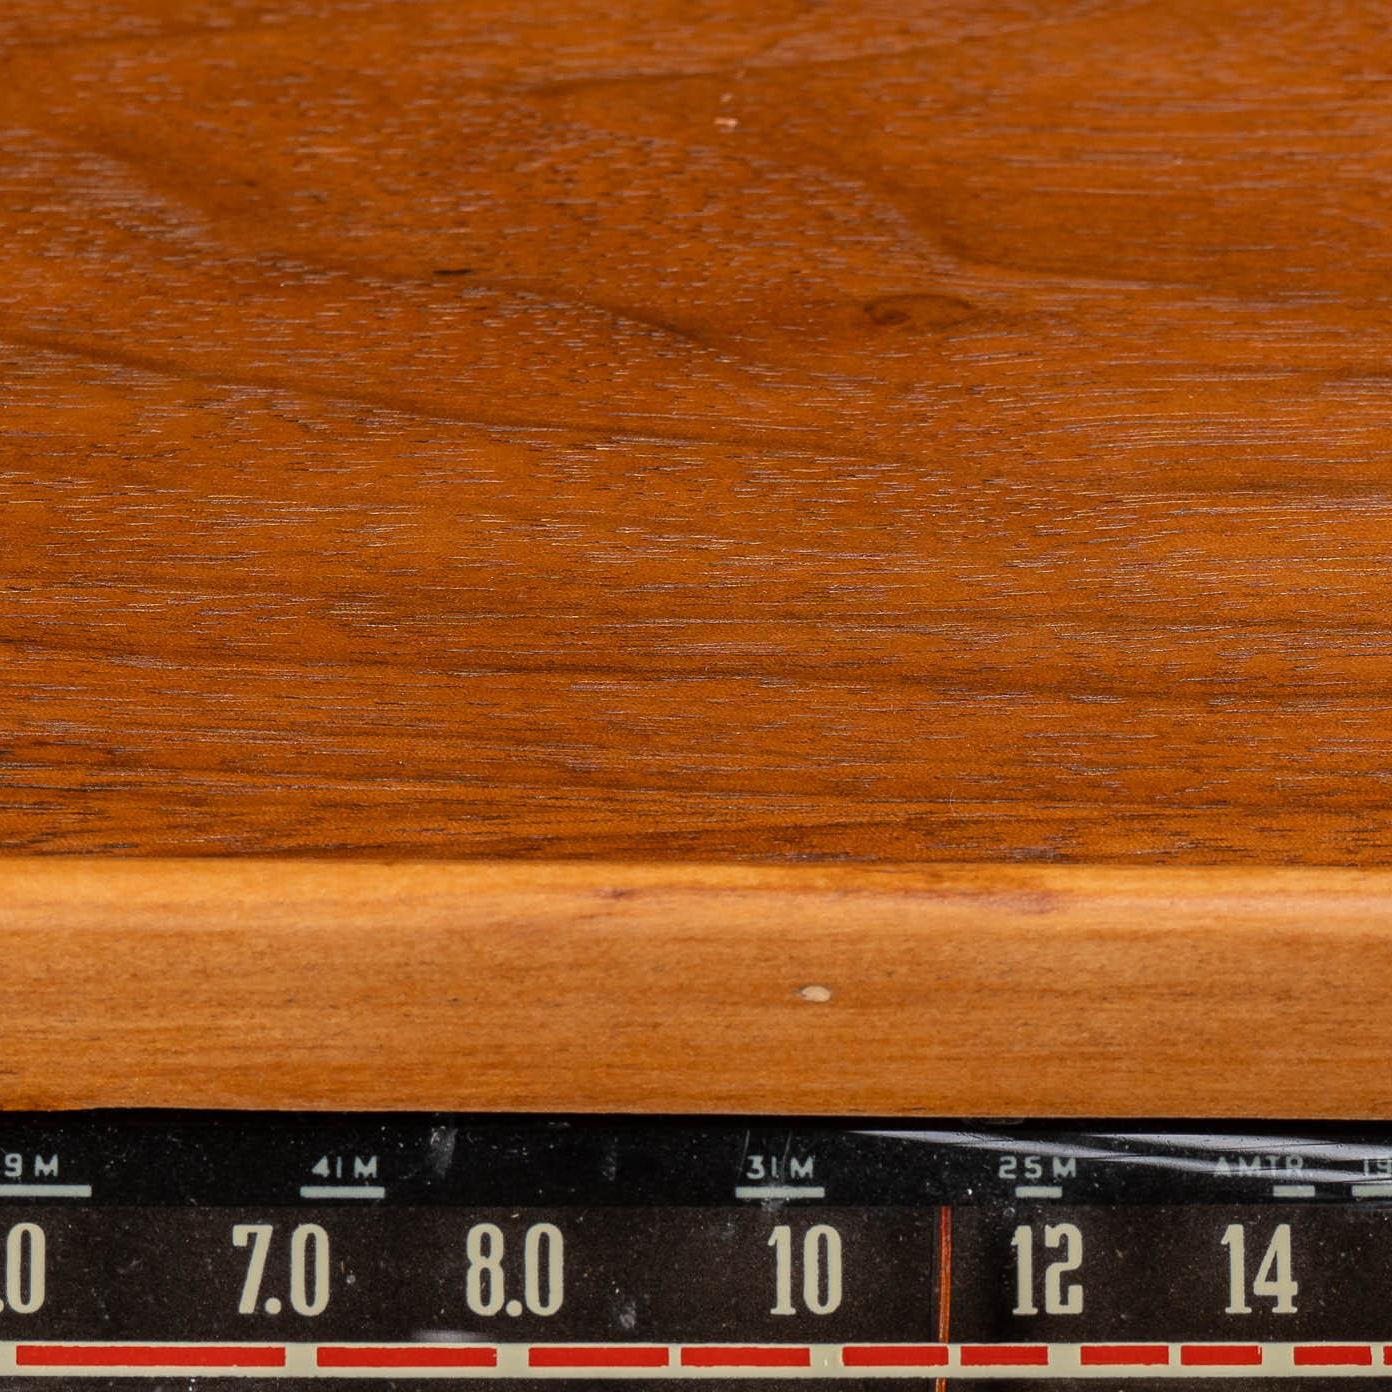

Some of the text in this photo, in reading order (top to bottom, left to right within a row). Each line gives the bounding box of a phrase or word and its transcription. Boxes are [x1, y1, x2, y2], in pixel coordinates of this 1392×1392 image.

[231, 1222, 331, 1316] 7.0
[465, 1222, 565, 1317] 8.0
[767, 1224, 843, 1316] 10
[1010, 1221, 1084, 1316] 12
[1219, 1223, 1299, 1314] 14
